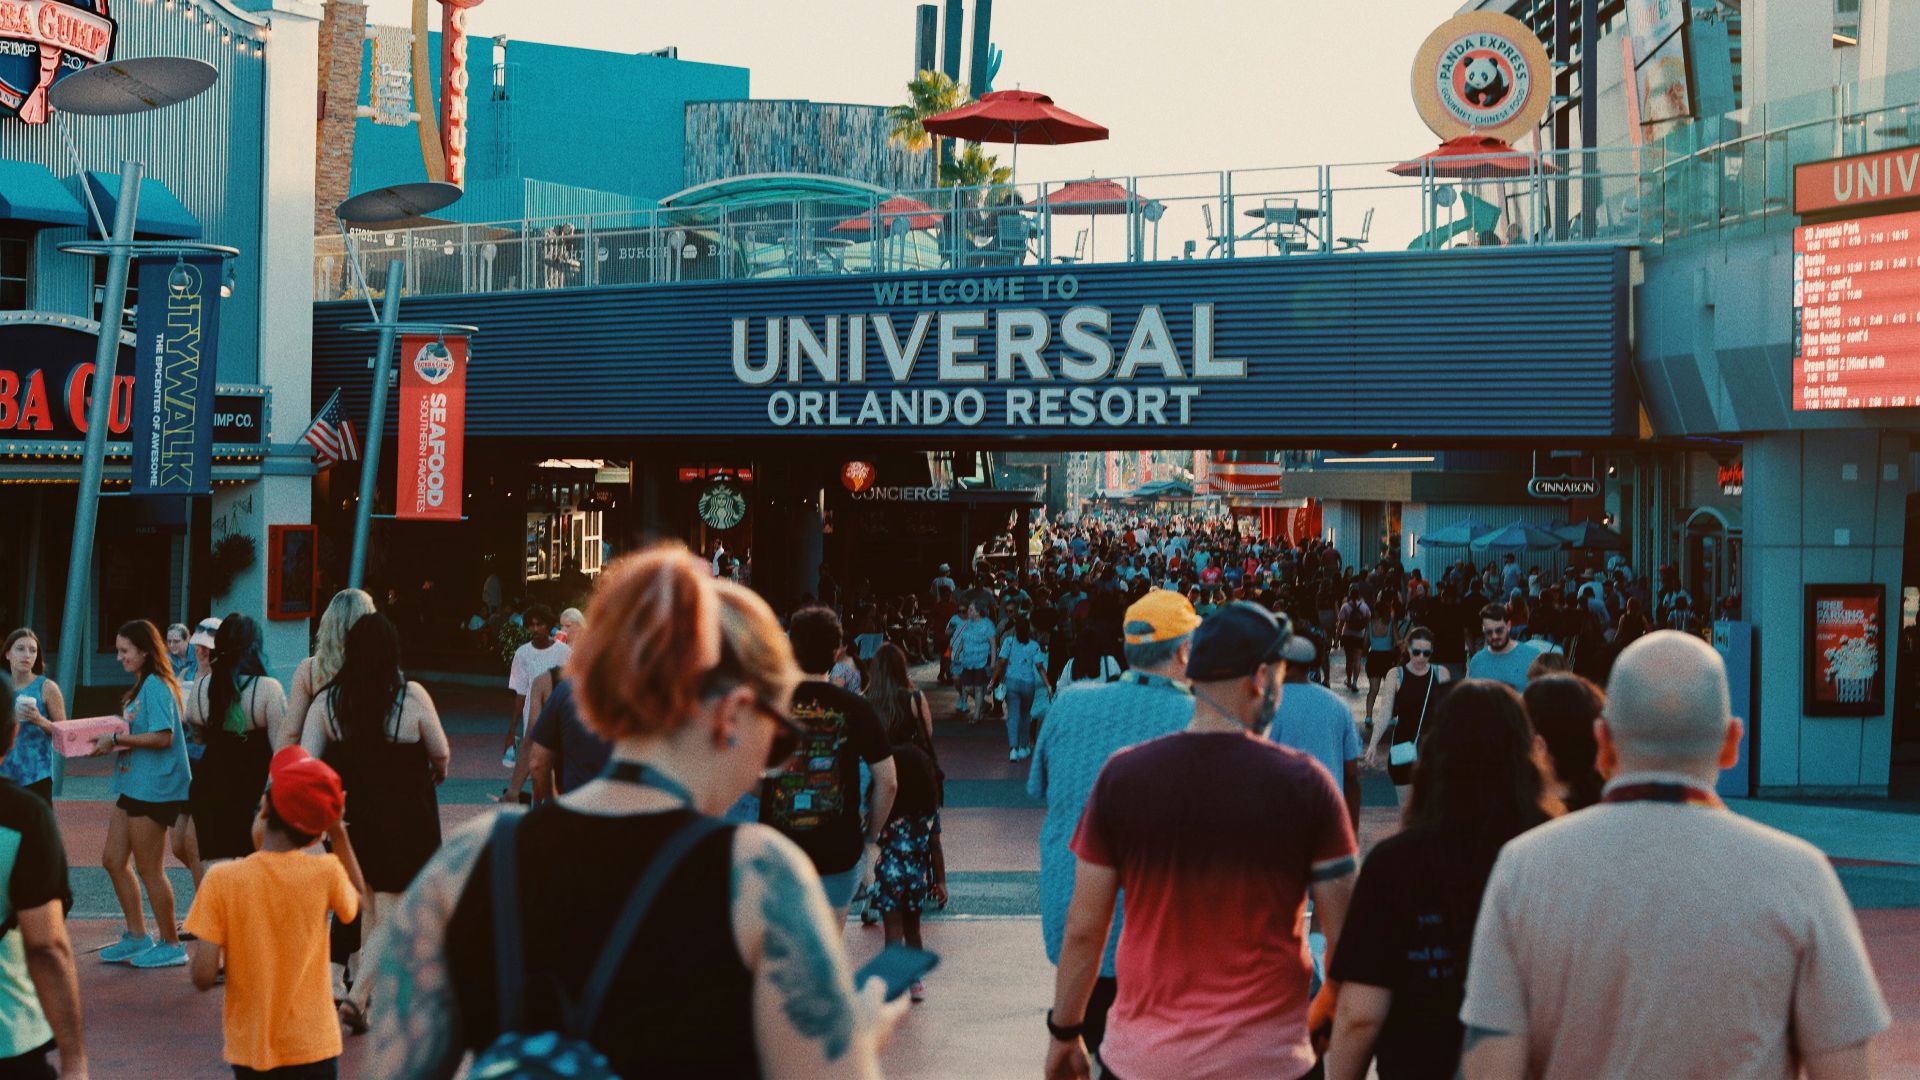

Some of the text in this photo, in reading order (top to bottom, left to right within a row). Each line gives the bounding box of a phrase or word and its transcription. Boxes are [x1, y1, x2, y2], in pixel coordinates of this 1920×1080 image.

[0, 2, 108, 56] BA GUMP
[1440, 36, 1526, 80] PANDA EXPRESS
[1442, 88, 1524, 124] GOURMET CHINESE FOOD
[1834, 153, 1920, 202] UNIV
[402, 235, 437, 251] BRGER
[1843, 221, 1859, 236] Park
[873, 274, 1079, 306] WELCOME TO
[731, 302, 1248, 385] UNIVERSAL
[1839, 357, 1846, 371] 2
[160, 263, 203, 487] CITYWALK
[0, 368, 53, 431] BA
[150, 333, 164, 489] THE EPICENTER OF AWESOME.
[235, 413, 254, 428] CO.
[767, 385, 1201, 427] ORLANDO RESORT
[416, 400, 429, 513] SOUTHERN FAVORITES
[426, 392, 447, 508] SEAFOOD
[851, 486, 950, 501] CONCIERGE
[1535, 481, 1594, 493] CINNABON
[1816, 609, 1865, 620] PARKING
